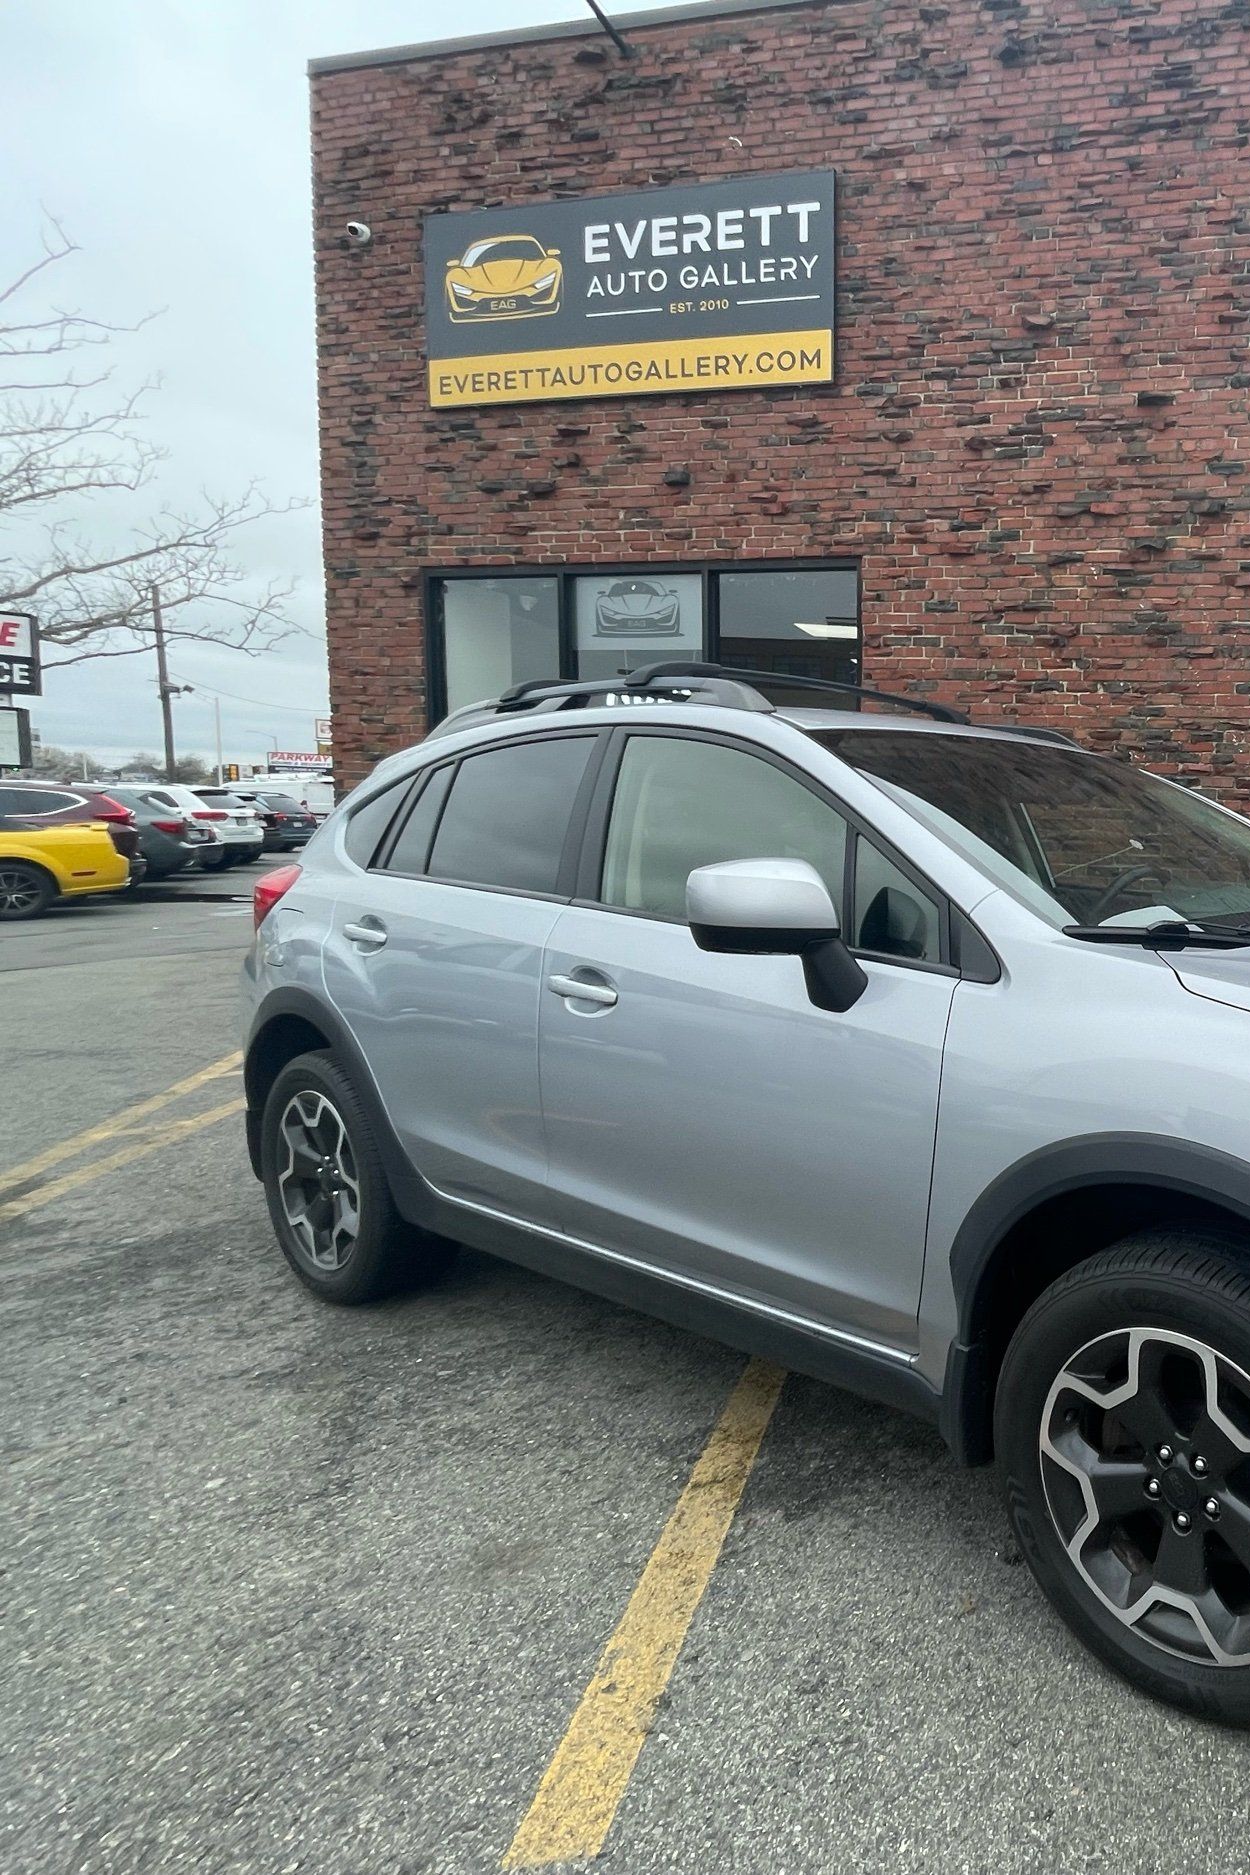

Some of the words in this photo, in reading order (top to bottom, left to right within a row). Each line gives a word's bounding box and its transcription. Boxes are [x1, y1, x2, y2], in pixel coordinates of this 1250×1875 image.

[584, 202, 821, 263] EVERETT
[587, 268, 668, 298] AUTO
[679, 255, 820, 290] GALLERY
[490, 299, 517, 311] EAG
[669, 302, 696, 314] EST.
[700, 299, 729, 311] 2010
[439, 348, 821, 396] EVERETTAUTOGALLERY.COM
[271, 752, 330, 762] PARKWAY
